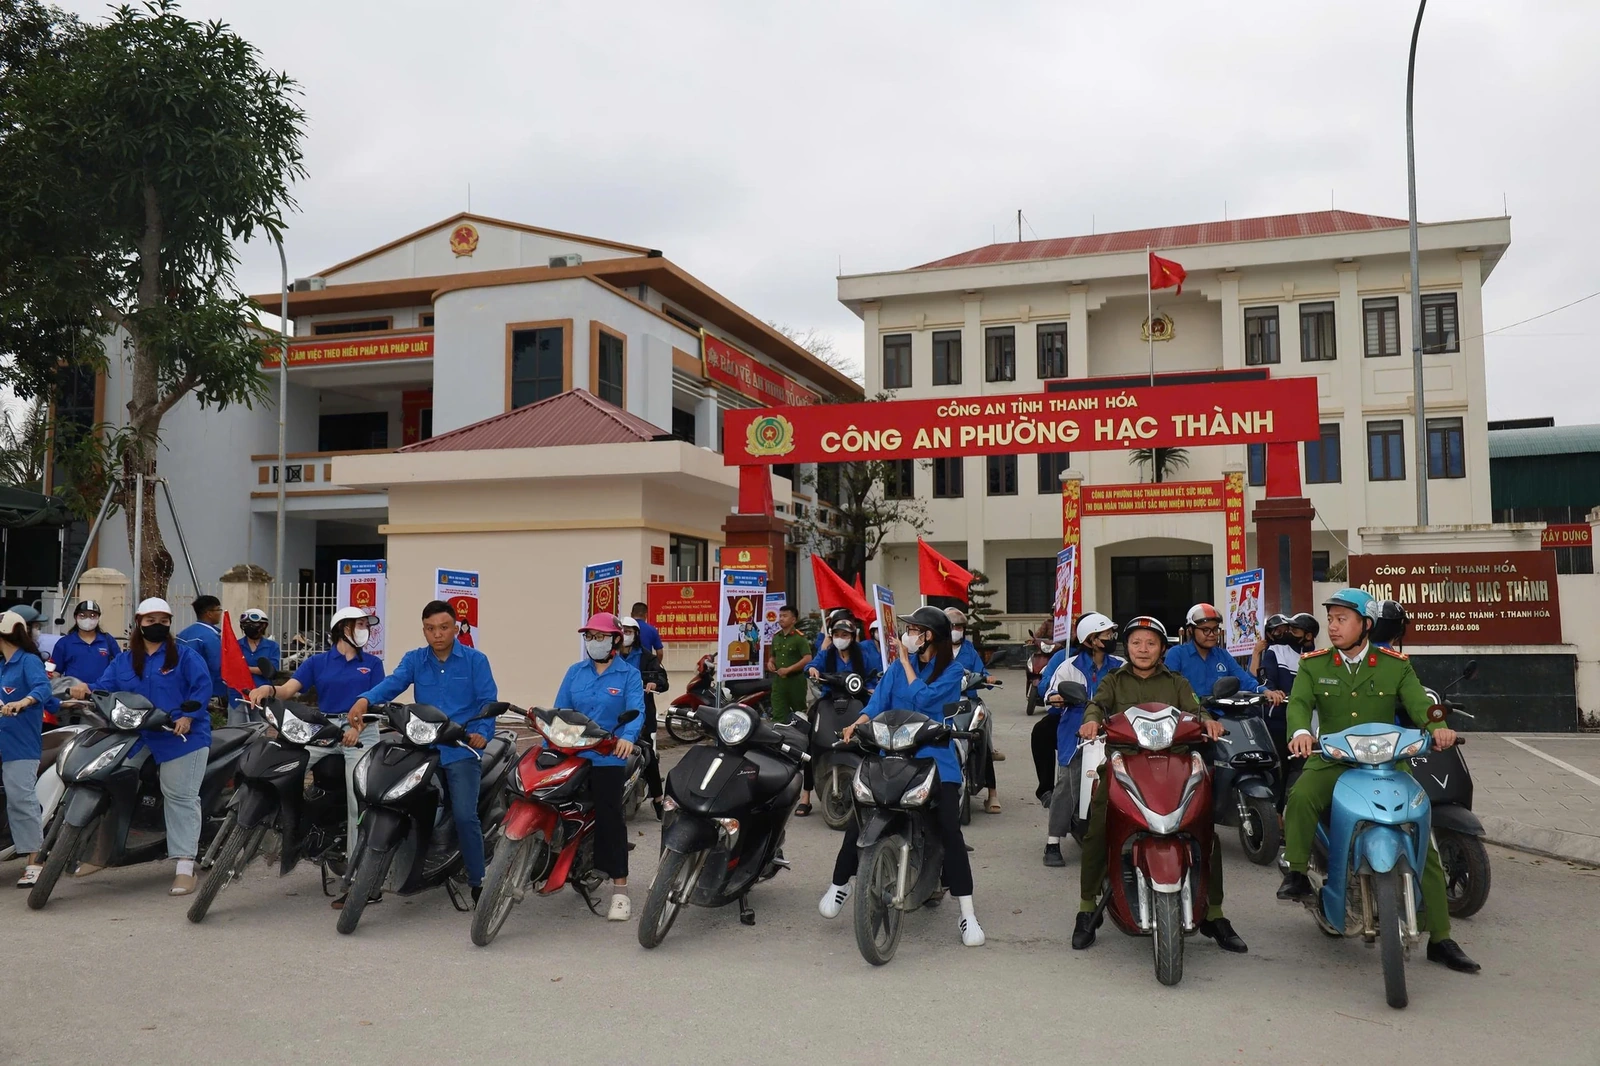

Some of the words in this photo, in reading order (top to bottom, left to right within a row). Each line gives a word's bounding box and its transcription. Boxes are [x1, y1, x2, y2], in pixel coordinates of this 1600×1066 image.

[307, 348, 322, 362] VIỆC
[323, 348, 341, 358] THEO
[341, 345, 358, 357] HIẾN
[359, 344, 378, 356] PHÁP
[379, 342, 389, 354] VÀ
[390, 342, 409, 354] PHÁP
[410, 340, 428, 354] LUẬT
[719, 350, 739, 377] BẢO
[740, 363, 751, 388] VỆ
[752, 372, 764, 391] AN
[937, 400, 981, 417] CÔNG
[984, 402, 1006, 415] AN
[1011, 397, 1043, 414] TỈNH
[1049, 397, 1098, 412] THANH
[1105, 391, 1138, 409] HÓA
[820, 424, 903, 453] CÔNG
[912, 426, 951, 450] AN
[960, 415, 1080, 447] PHƯỜNG
[1094, 416, 1159, 447] HẠC
[1171, 405, 1274, 437] THÀNH
[1091, 488, 1105, 499] CÔNG
[1105, 490, 1112, 498] AN
[1113, 488, 1133, 498] PHƯỜNG
[1133, 489, 1144, 499] HẠC
[1144, 487, 1161, 497] THÀNH
[1186, 486, 1196, 496] SỨC
[1094, 502, 1103, 511] ĐUA
[1103, 501, 1116, 510] HOÀN
[1117, 500, 1133, 509] THÀNH
[1134, 499, 1147, 509] XUẤT
[1147, 499, 1158, 509] SẮC
[1158, 499, 1168, 510] MỌI
[1168, 498, 1185, 509] NHIỆM
[1186, 498, 1193, 509] VỤ
[1193, 498, 1206, 509] ĐƯỢC
[1230, 510, 1239, 522] ĐẤT
[1228, 525, 1242, 536] NƯỚC
[1542, 529, 1560, 542] XÂY
[1562, 529, 1588, 544] DỰNG
[1375, 564, 1406, 575] CÔNG
[1411, 566, 1425, 574] AN
[1429, 562, 1451, 574] TỈNH
[1455, 564, 1490, 574] THANH
[1493, 559, 1517, 573] HÓA
[1399, 583, 1417, 604] AN
[1421, 577, 1471, 604] PHƯỜNG
[1476, 581, 1502, 606] HẠC
[1506, 575, 1549, 602] THÀNH
[1417, 611, 1434, 619] NHO
[1449, 611, 1466, 621] HẠC
[1468, 609, 1494, 619] THÀNH
[1533, 607, 1550, 618] HÓA
